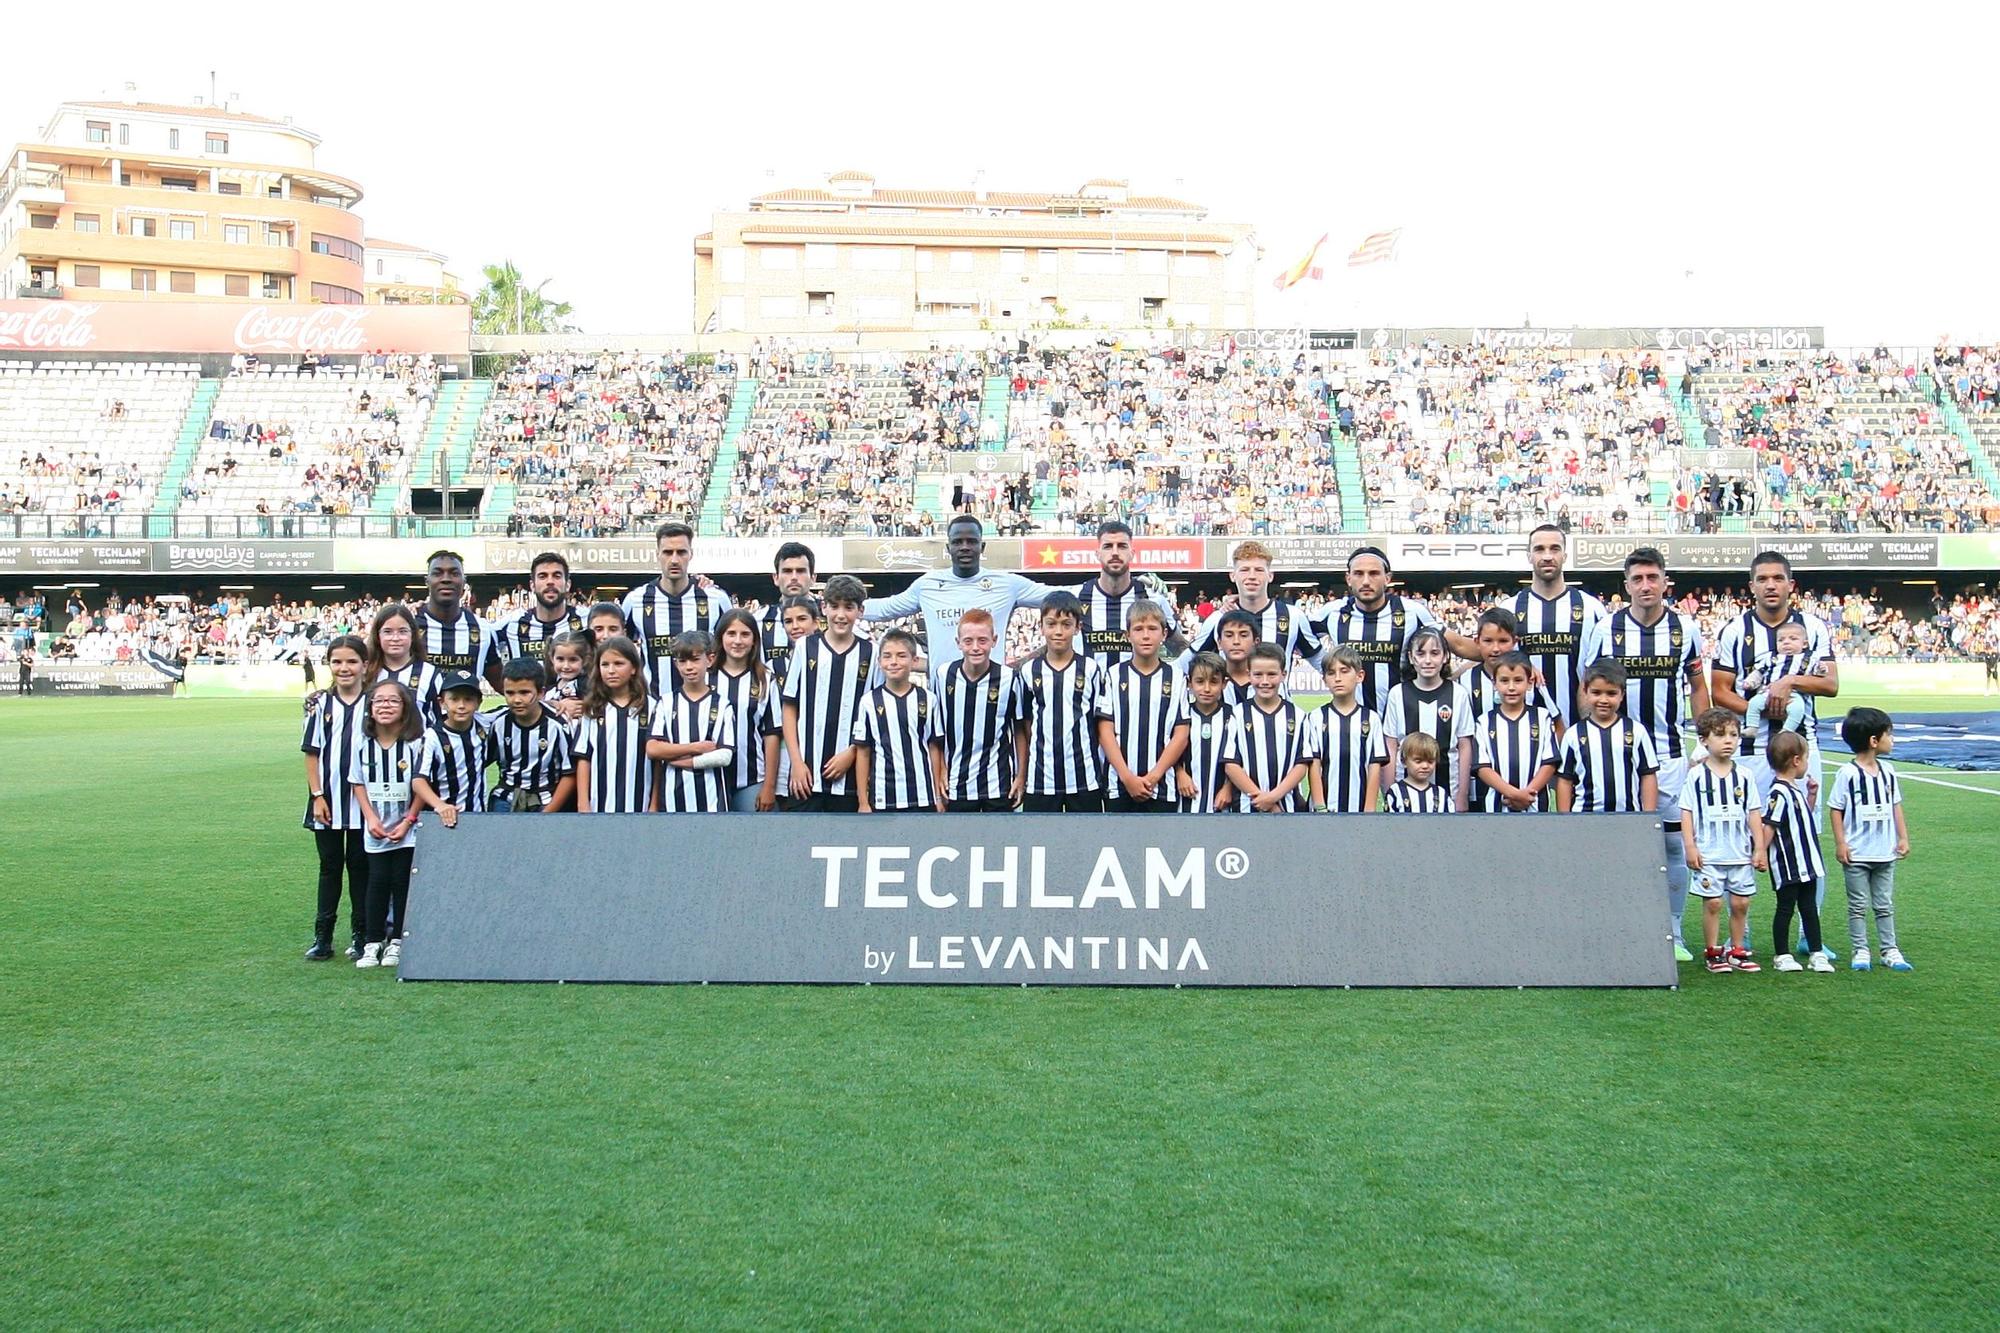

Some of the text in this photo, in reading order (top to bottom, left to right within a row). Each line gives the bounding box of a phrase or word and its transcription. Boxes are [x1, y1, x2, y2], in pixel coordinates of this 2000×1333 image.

[234, 306, 373, 349] Coca-Cola
[169, 544, 255, 563] Bravoplaya
[1303, 540, 1315, 548] DE
[1319, 540, 1366, 548] NEGOCIOS
[1140, 550, 1190, 564] DAMM
[864, 936, 1209, 975] by LEVANTINA
